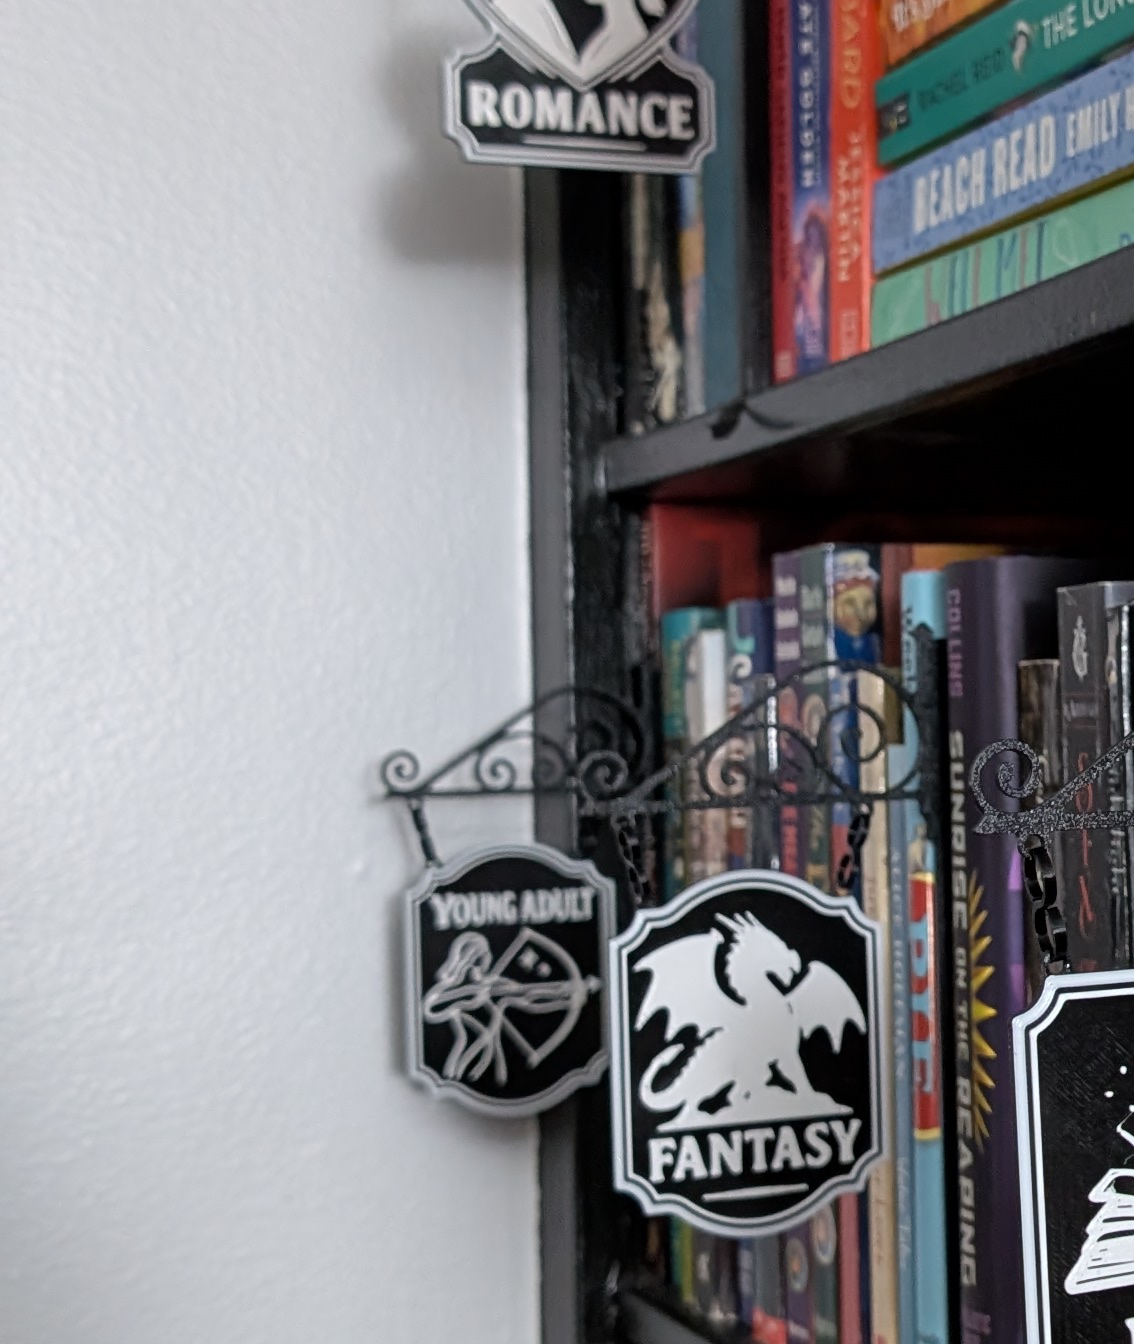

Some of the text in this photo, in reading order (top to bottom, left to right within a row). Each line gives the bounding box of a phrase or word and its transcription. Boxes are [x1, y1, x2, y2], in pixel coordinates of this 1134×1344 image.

[1041, 2, 1078, 50] THE
[466, 80, 695, 140] ROMANCE
[913, 148, 986, 235] BEACH
[993, 115, 1056, 197] READ
[1065, 92, 1121, 157] EMILY
[947, 588, 964, 699] COLLINS
[429, 886, 595, 930] YOUNG ADULT
[950, 730, 978, 1288] SUNRISE ON THE REAPING
[647, 1118, 862, 1184] FANTASY
